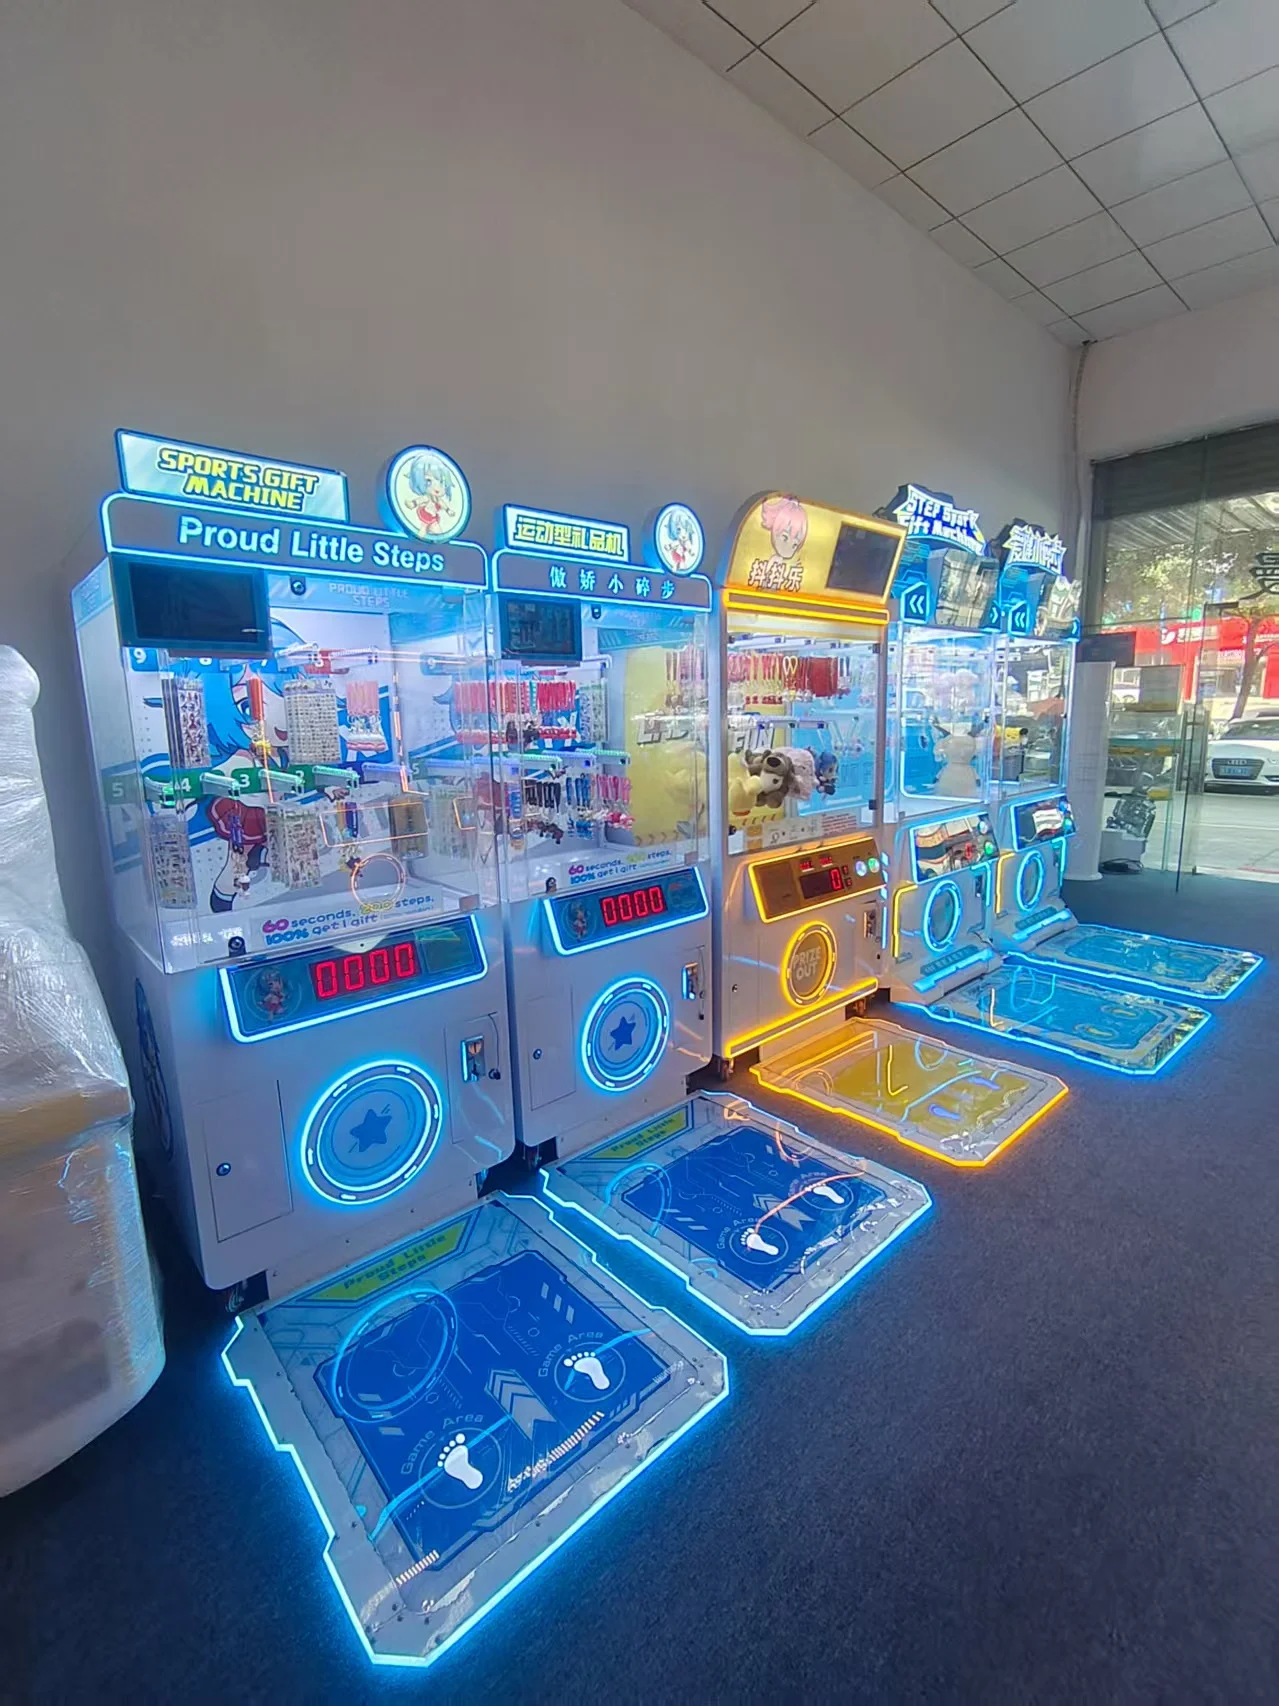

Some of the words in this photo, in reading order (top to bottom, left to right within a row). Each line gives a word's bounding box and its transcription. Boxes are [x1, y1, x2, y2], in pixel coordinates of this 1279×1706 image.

[158, 448, 261, 484] SPORTS
[263, 467, 320, 495] GIFT
[183, 474, 305, 512] MACHINE
[178, 516, 280, 554] Proud
[290, 530, 364, 563] Little
[372, 541, 445, 573] Steps
[514, 516, 624, 556] 运动型礼品机
[549, 565, 675, 600] 傲娇小碎步
[748, 558, 804, 592] 抖抖乐
[133, 648, 147, 664] 9
[112, 782, 124, 798] 5
[180, 777, 192, 792] 4
[239, 774, 251, 788] 3
[568, 864, 585, 876] 60
[570, 872, 596, 884] 100%
[831, 868, 842, 892] 0
[602, 886, 664, 926] 0000
[262, 918, 290, 934] 60
[265, 928, 309, 946] 100%
[312, 922, 340, 936] get
[351, 913, 379, 928] gift
[316, 943, 415, 998] 0000
[793, 946, 822, 969] PRIZE
[796, 961, 818, 981] OUT
[343, 1258, 394, 1289] Proud
[537, 1343, 564, 1378] Game
[567, 1331, 604, 1344] Area
[400, 1430, 436, 1476] Game
[442, 1413, 485, 1430] Area
